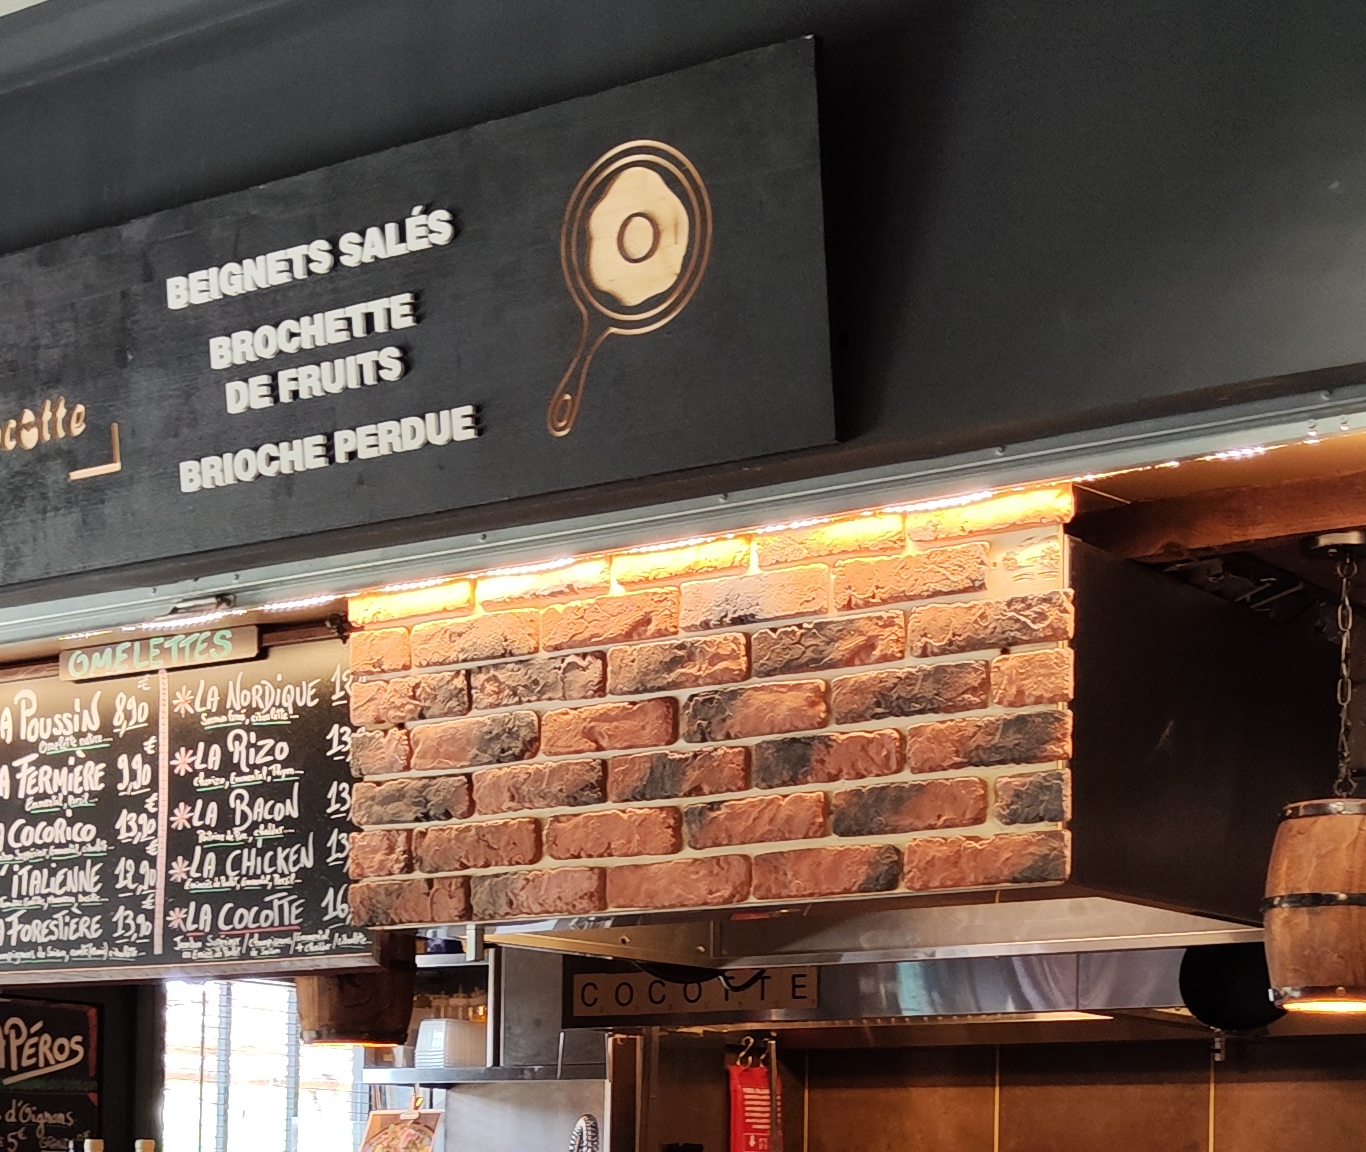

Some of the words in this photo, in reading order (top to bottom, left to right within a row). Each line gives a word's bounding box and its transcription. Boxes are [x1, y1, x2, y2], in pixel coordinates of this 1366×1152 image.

[166, 238, 336, 311] BEIGNETS
[336, 205, 456, 271] SALÉS
[208, 293, 418, 372] BROCHETTE
[225, 366, 273, 415] DE
[276, 346, 408, 409] FRUITS
[178, 433, 330, 494] BRIOCHE
[332, 404, 479, 465] PERDUE
[67, 629, 234, 678] OMELETTES
[14, 688, 102, 741] POUSSIN
[194, 679, 220, 713] LA
[226, 671, 321, 714] NORDIQUE
[194, 742, 221, 770] LA
[8, 809, 97, 848] COCORICO
[192, 799, 218, 827] LA
[229, 782, 300, 830] BACON
[189, 845, 217, 878] LA
[225, 831, 315, 876] CHICKEN
[186, 901, 212, 932] LA
[218, 892, 306, 930] COCOTTE
